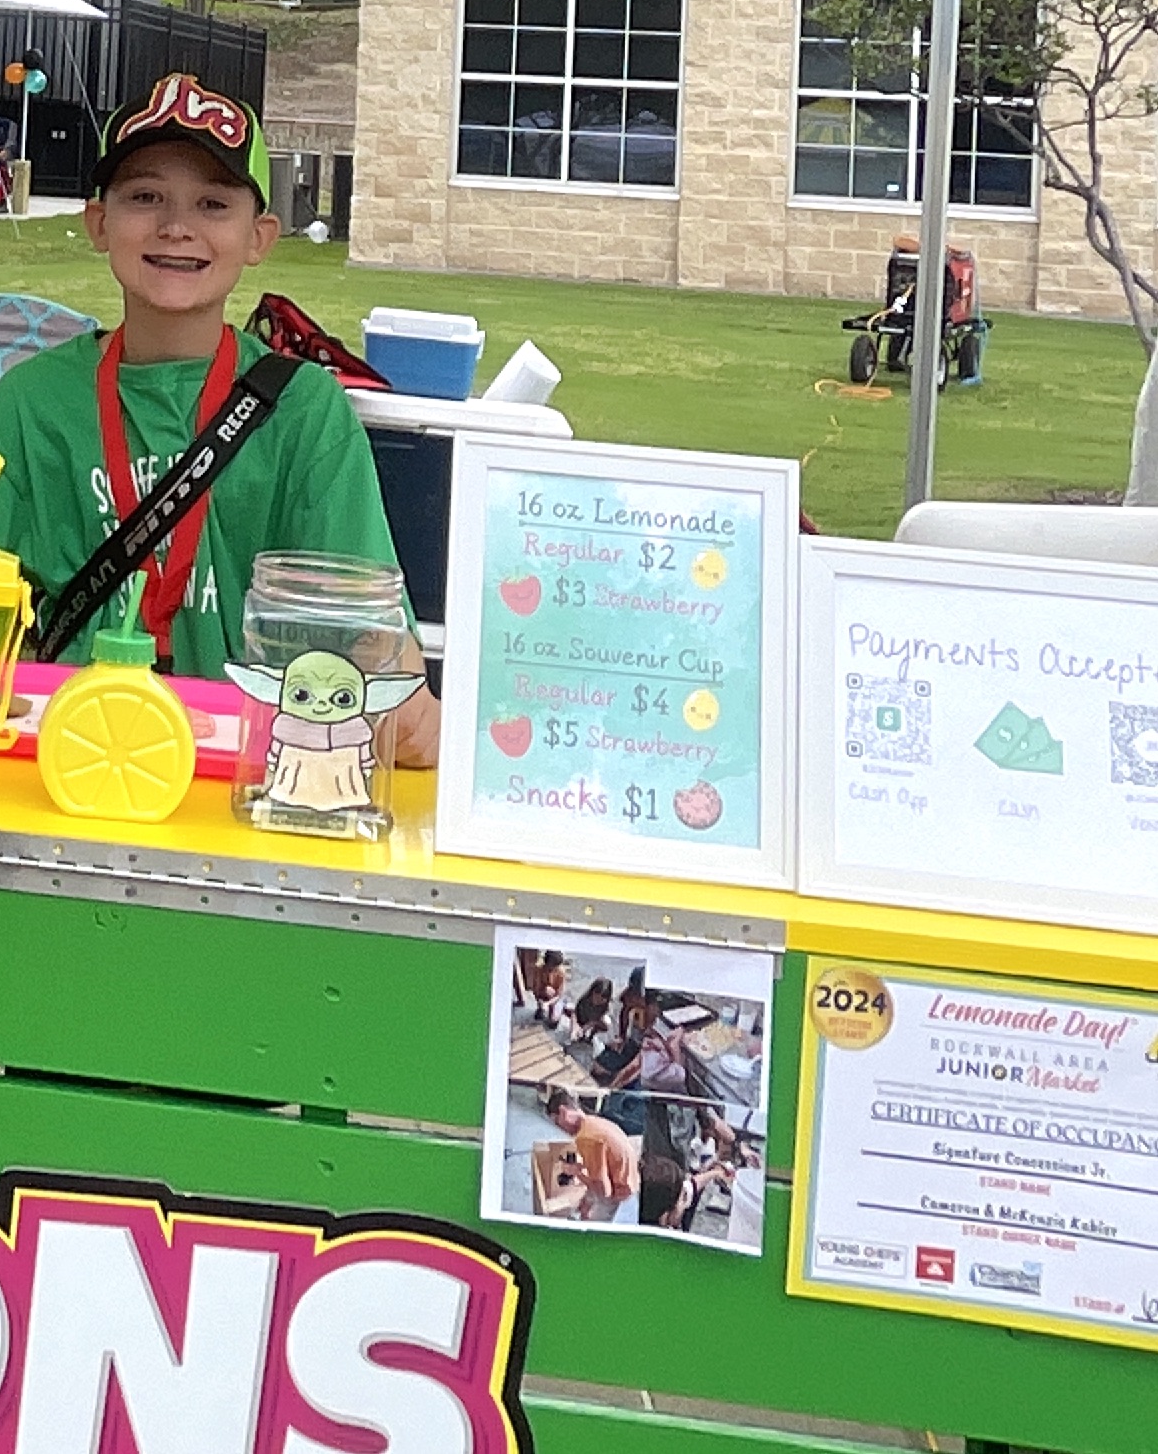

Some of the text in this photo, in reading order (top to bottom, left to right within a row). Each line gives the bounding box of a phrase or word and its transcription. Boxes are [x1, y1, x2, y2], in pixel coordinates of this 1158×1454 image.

[518, 490, 736, 537] 16 oz Lemonade
[522, 531, 678, 573] Regular $2
[552, 575, 724, 625] $3 Strawberry
[503, 631, 725, 683] 16 oz Souvenir Cup
[848, 622, 1021, 684] Payments
[514, 672, 671, 717] Regular $4
[542, 717, 719, 768] $5 Strawberry
[506, 774, 660, 824] Snacks $1
[816, 984, 888, 1018] 2024
[927, 993, 1130, 1050] Lemonade Day!
[930, 1036, 1109, 1073] ROCKWALL AREA
[936, 1056, 1024, 1084] JUNIOR
[871, 1099, 1009, 1136] CERTIFICATE
[1012, 1117, 1043, 1139] OF
[932, 1140, 1001, 1163] Signature
[920, 1194, 980, 1216] Cameron
